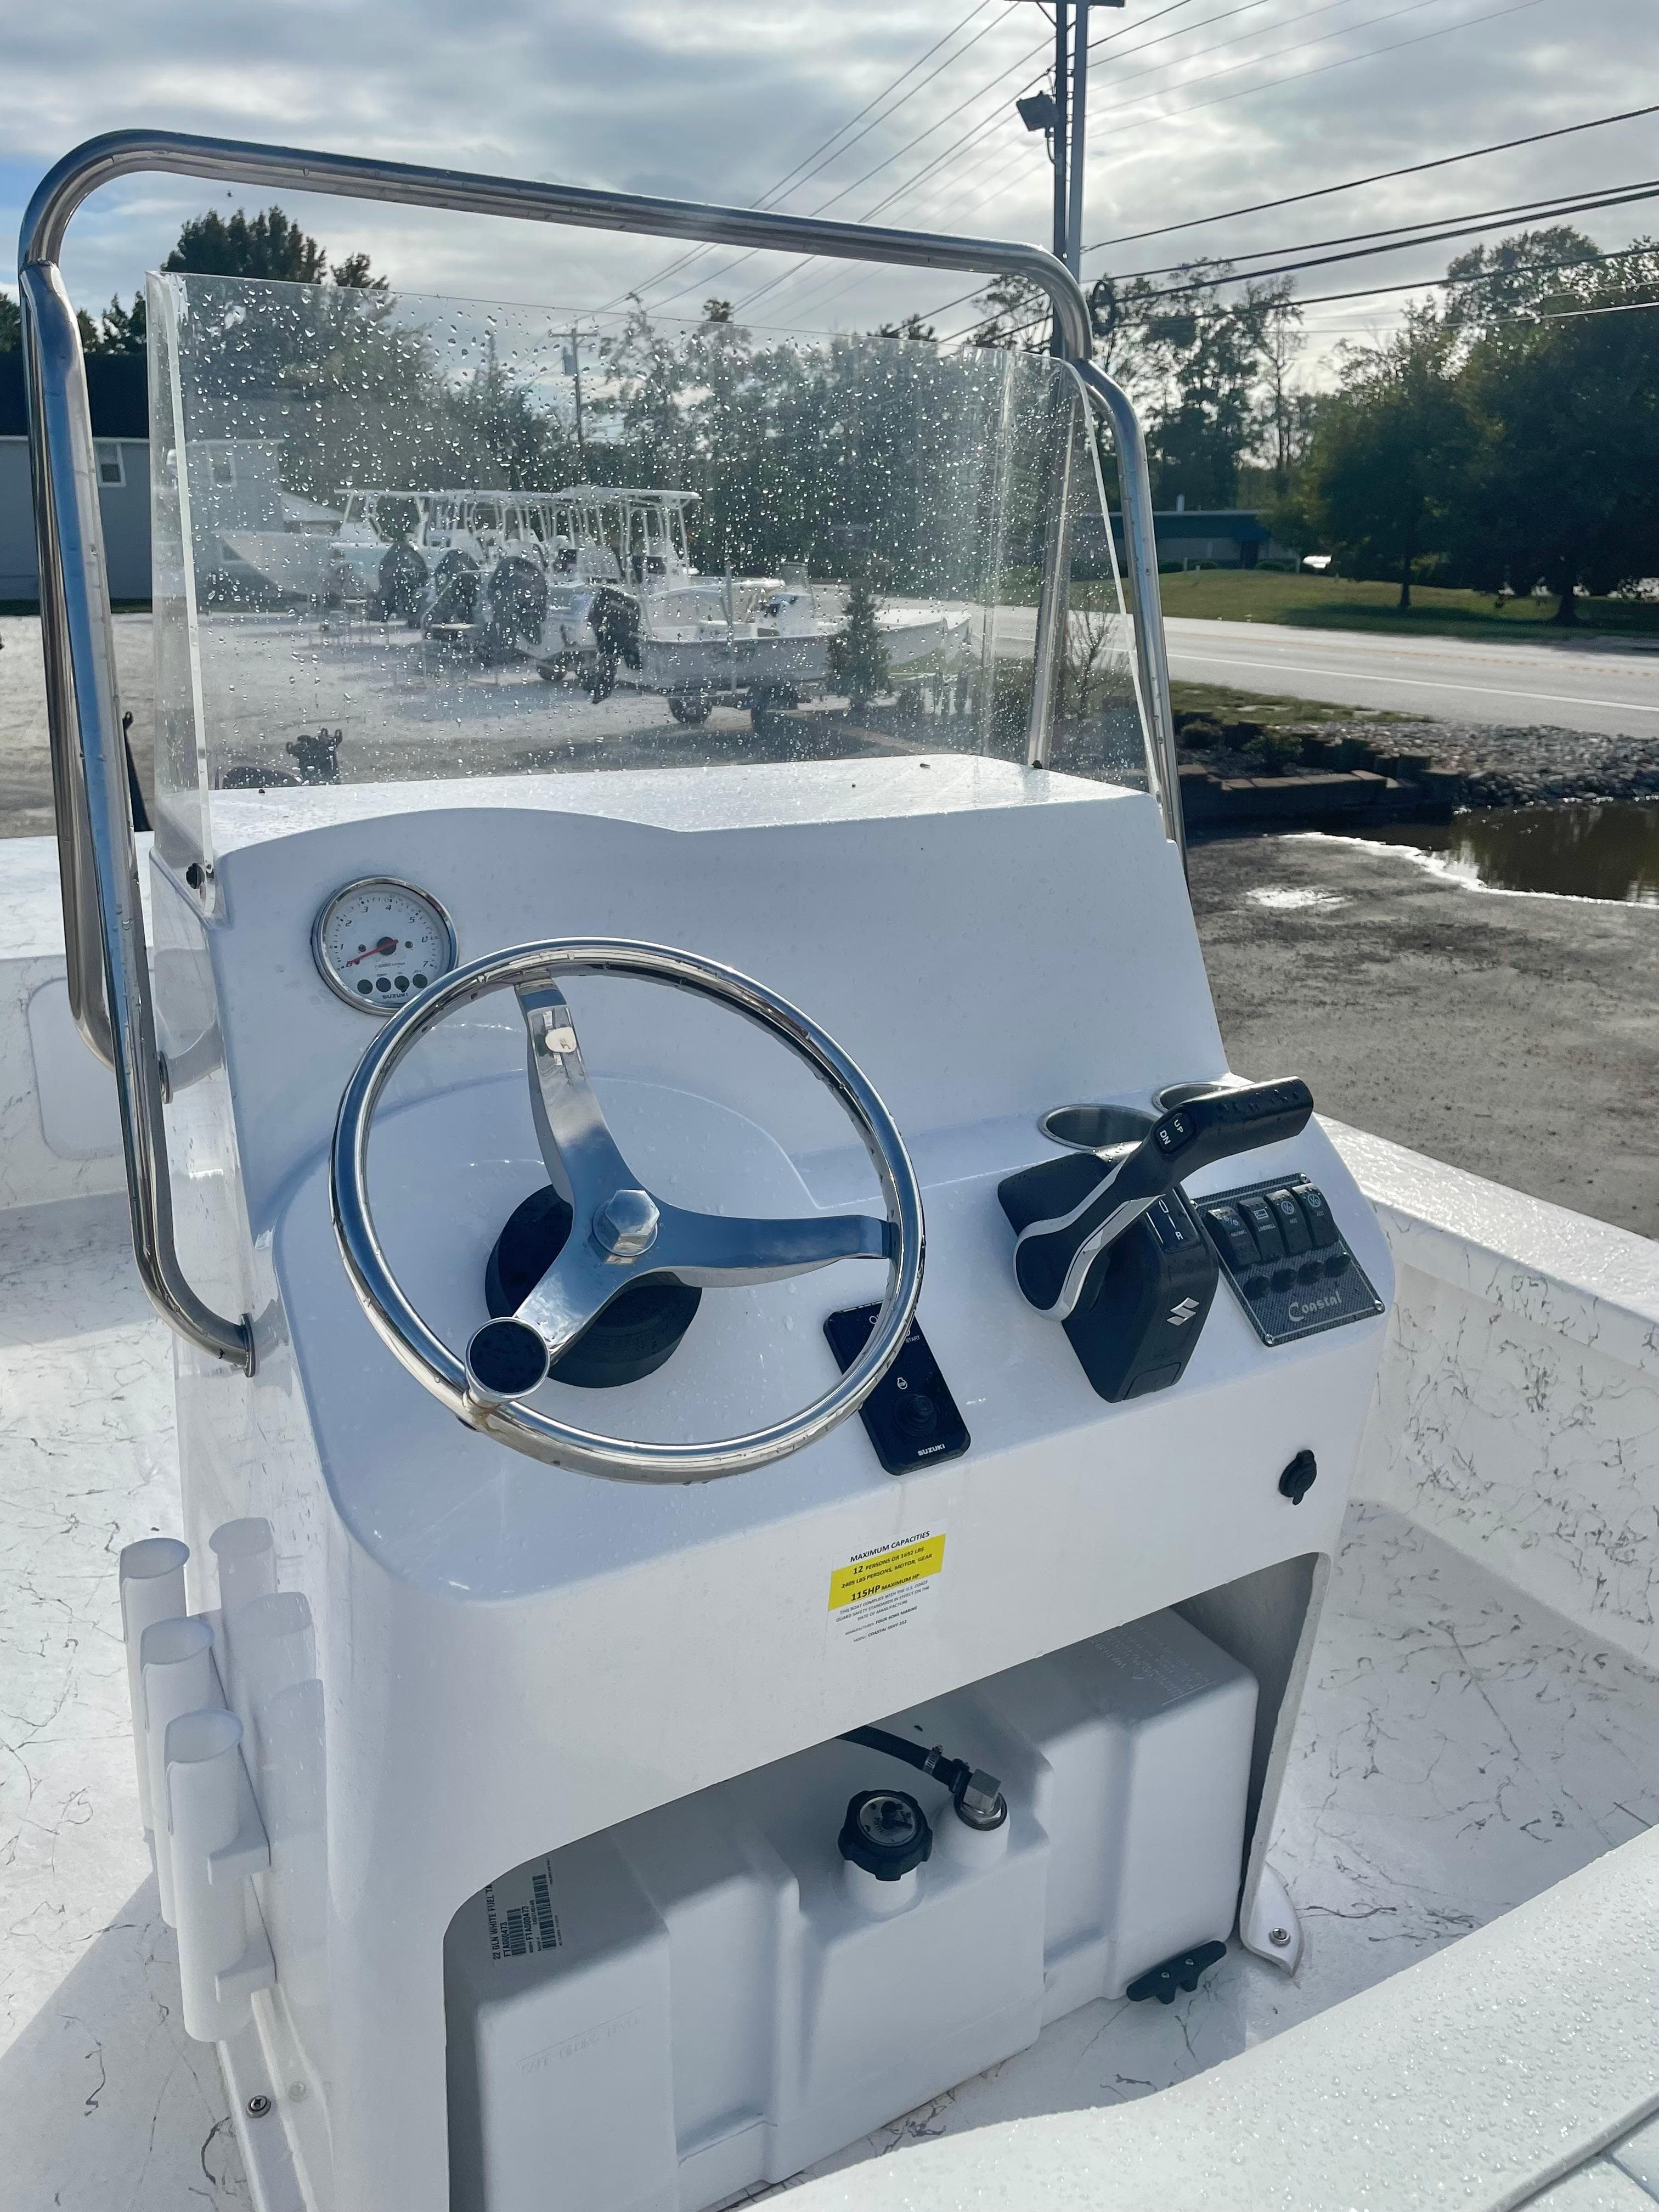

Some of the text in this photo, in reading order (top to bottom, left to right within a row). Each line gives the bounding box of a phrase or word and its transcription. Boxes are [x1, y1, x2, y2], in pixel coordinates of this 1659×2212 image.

[1173, 1119, 1183, 1133] UP
[1159, 1130, 1171, 1145] DN
[1257, 1223, 1276, 1232] LIVEWELL
[1289, 1290, 1342, 1322] Coastal
[917, 1443, 945, 1456] SUZUKI
[850, 1531, 930, 1562] MAXIMUM CAPACITIES
[853, 1566, 863, 1575] 12
[865, 1559, 890, 1571] PERSONS
[866, 1567, 893, 1580] PERSONS,
[918, 1554, 932, 1562] GEAR
[851, 1585, 881, 1601] 115HP
[881, 1577, 911, 1590] MAXIMUM
[914, 1580, 928, 1588] COAST
[836, 1614, 851, 1622] GUARD
[852, 1608, 868, 1616] SAFETY
[867, 1628, 887, 1637] COASTAL
[487, 1894, 496, 1911] FUEL
[488, 1912, 498, 1935] WHITE
[493, 1951, 501, 1960] 22
